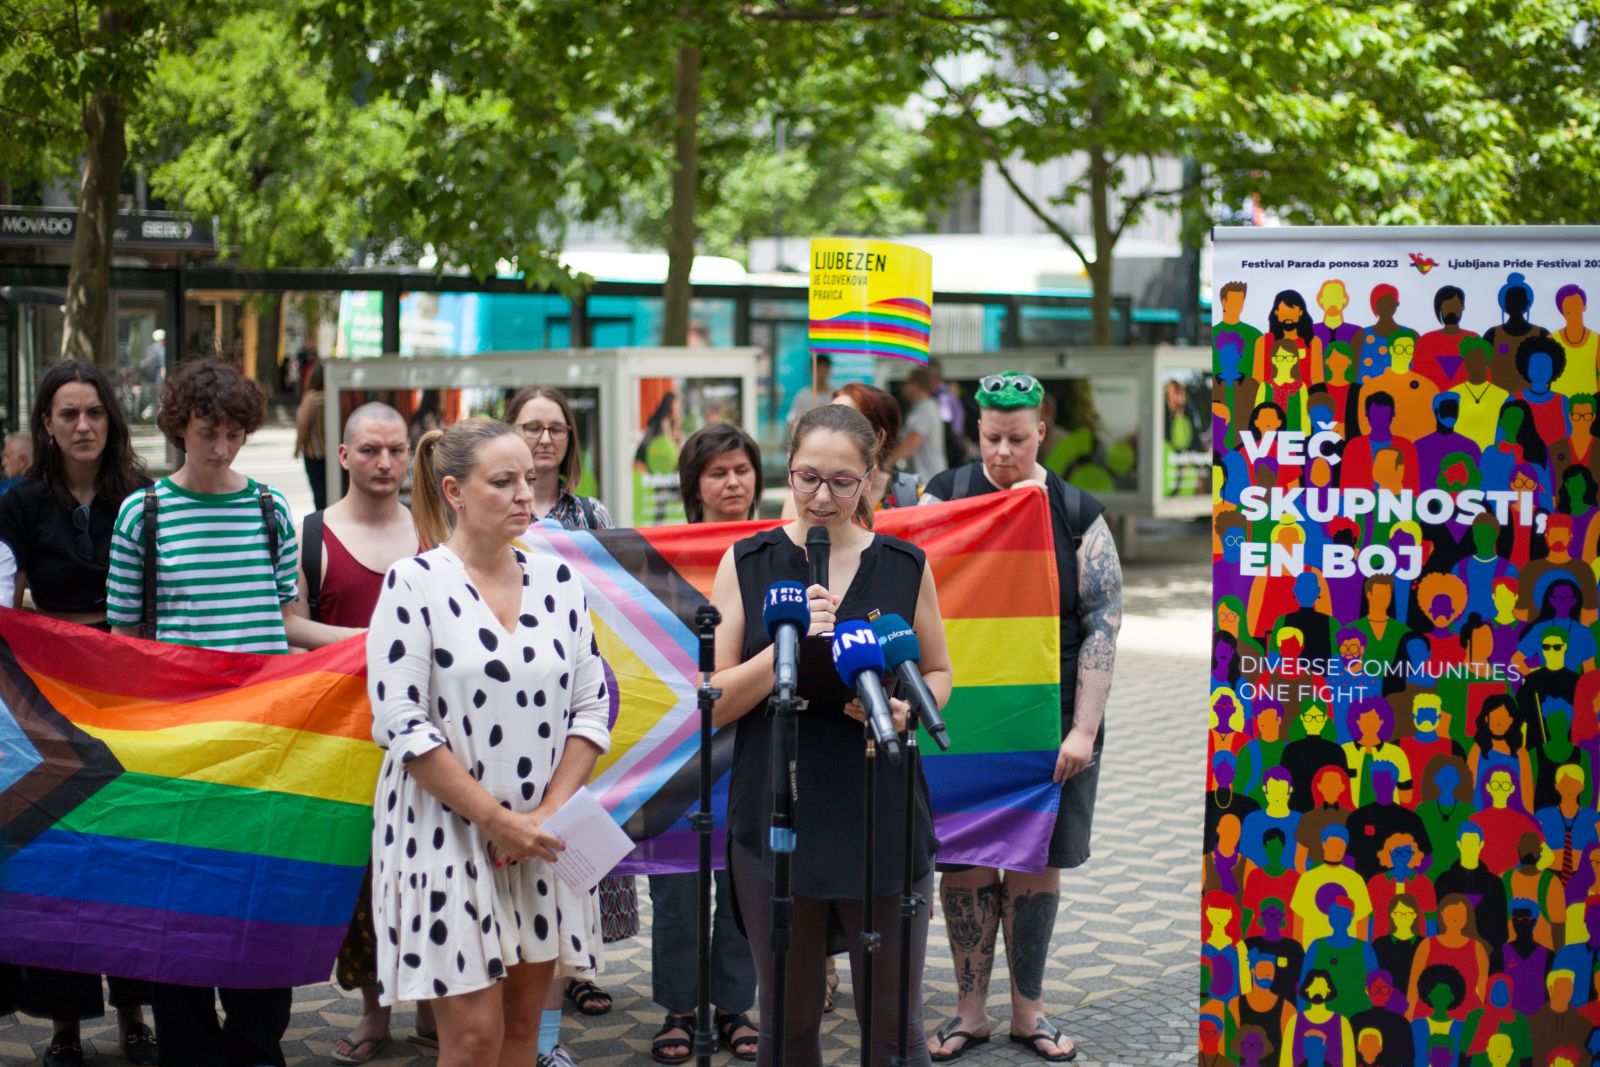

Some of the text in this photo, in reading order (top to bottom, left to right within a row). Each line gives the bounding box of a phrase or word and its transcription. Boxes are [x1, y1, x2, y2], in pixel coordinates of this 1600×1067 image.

[1, 216, 73, 235] MOVADO
[815, 251, 886, 272] LJUBEZEN
[1241, 259, 1399, 269] Festival Parada ponosa 2023
[1448, 258, 1500, 270] Ljubljana
[1503, 258, 1534, 268] Pride
[1537, 258, 1581, 268] Festival
[813, 272, 868, 286] JE ČLOVEKOVA
[813, 289, 843, 300] PRAVICA
[1239, 421, 1342, 466] VEČ
[1239, 486, 1548, 534] SKUPNOSTI,
[1240, 542, 1423, 581] EN BOJ
[780, 595, 803, 603] SLO
[841, 629, 876, 649] N1
[1240, 655, 1526, 685] DIVERSE COMMUNITIES,
[1239, 682, 1368, 704] ONE FIGHT
